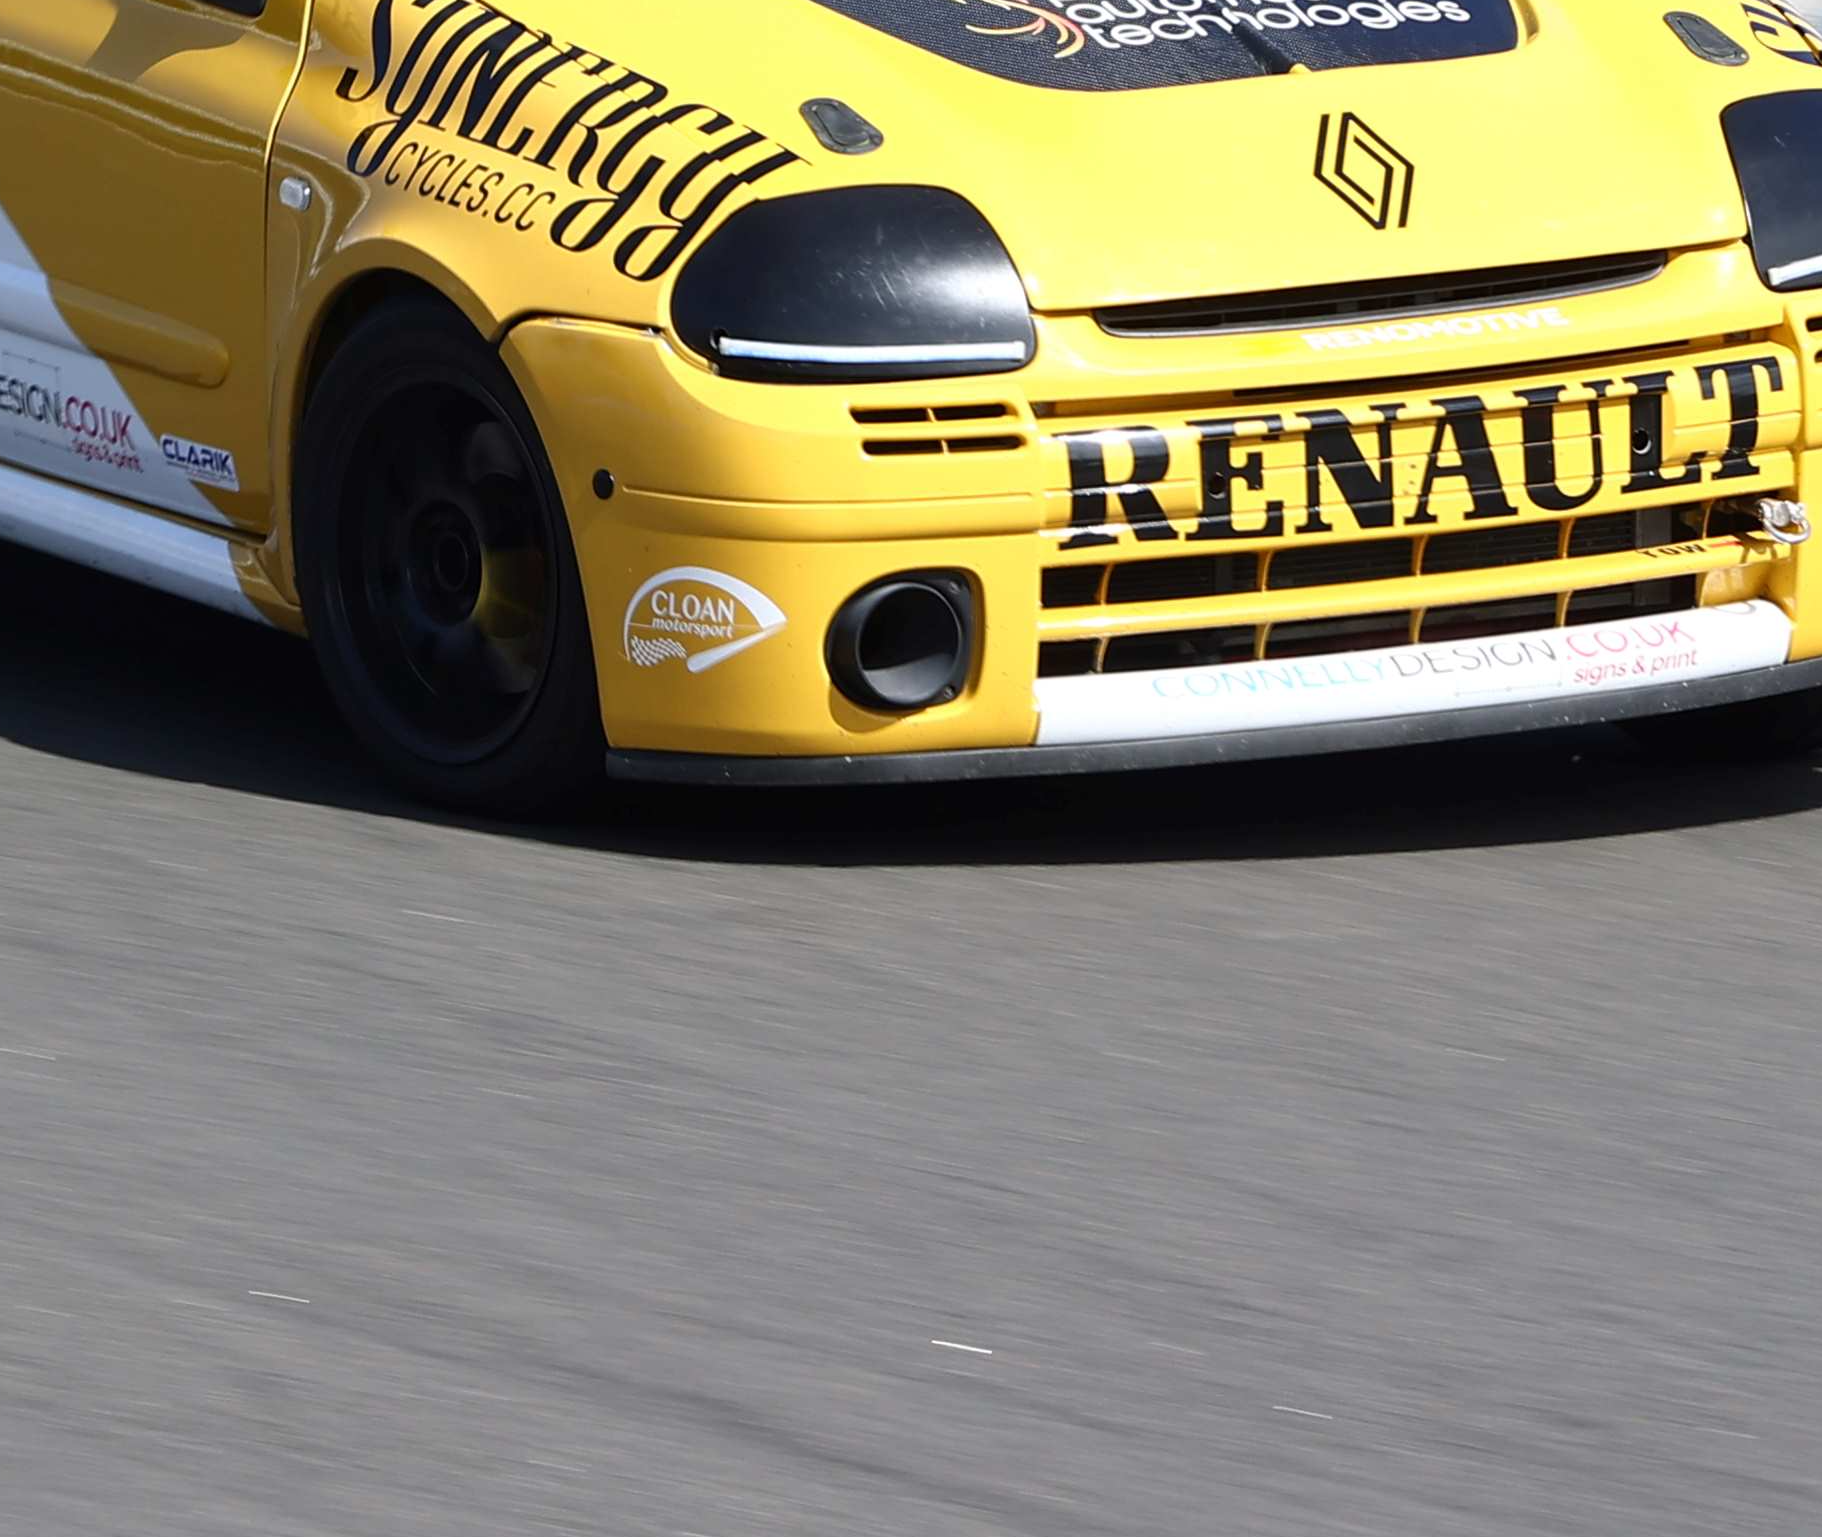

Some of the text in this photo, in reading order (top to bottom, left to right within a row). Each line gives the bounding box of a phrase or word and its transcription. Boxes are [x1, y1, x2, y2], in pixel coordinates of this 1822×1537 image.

[384, 140, 554, 233] CYCLES.CC
[1299, 306, 1570, 351] RENOMOTIVE
[1053, 355, 1784, 553] RENAULT
[1638, 541, 1707, 559] TOW
[651, 589, 736, 625] CLOAN
[651, 616, 734, 640] motorsport
[1572, 647, 1700, 689] signs & print
